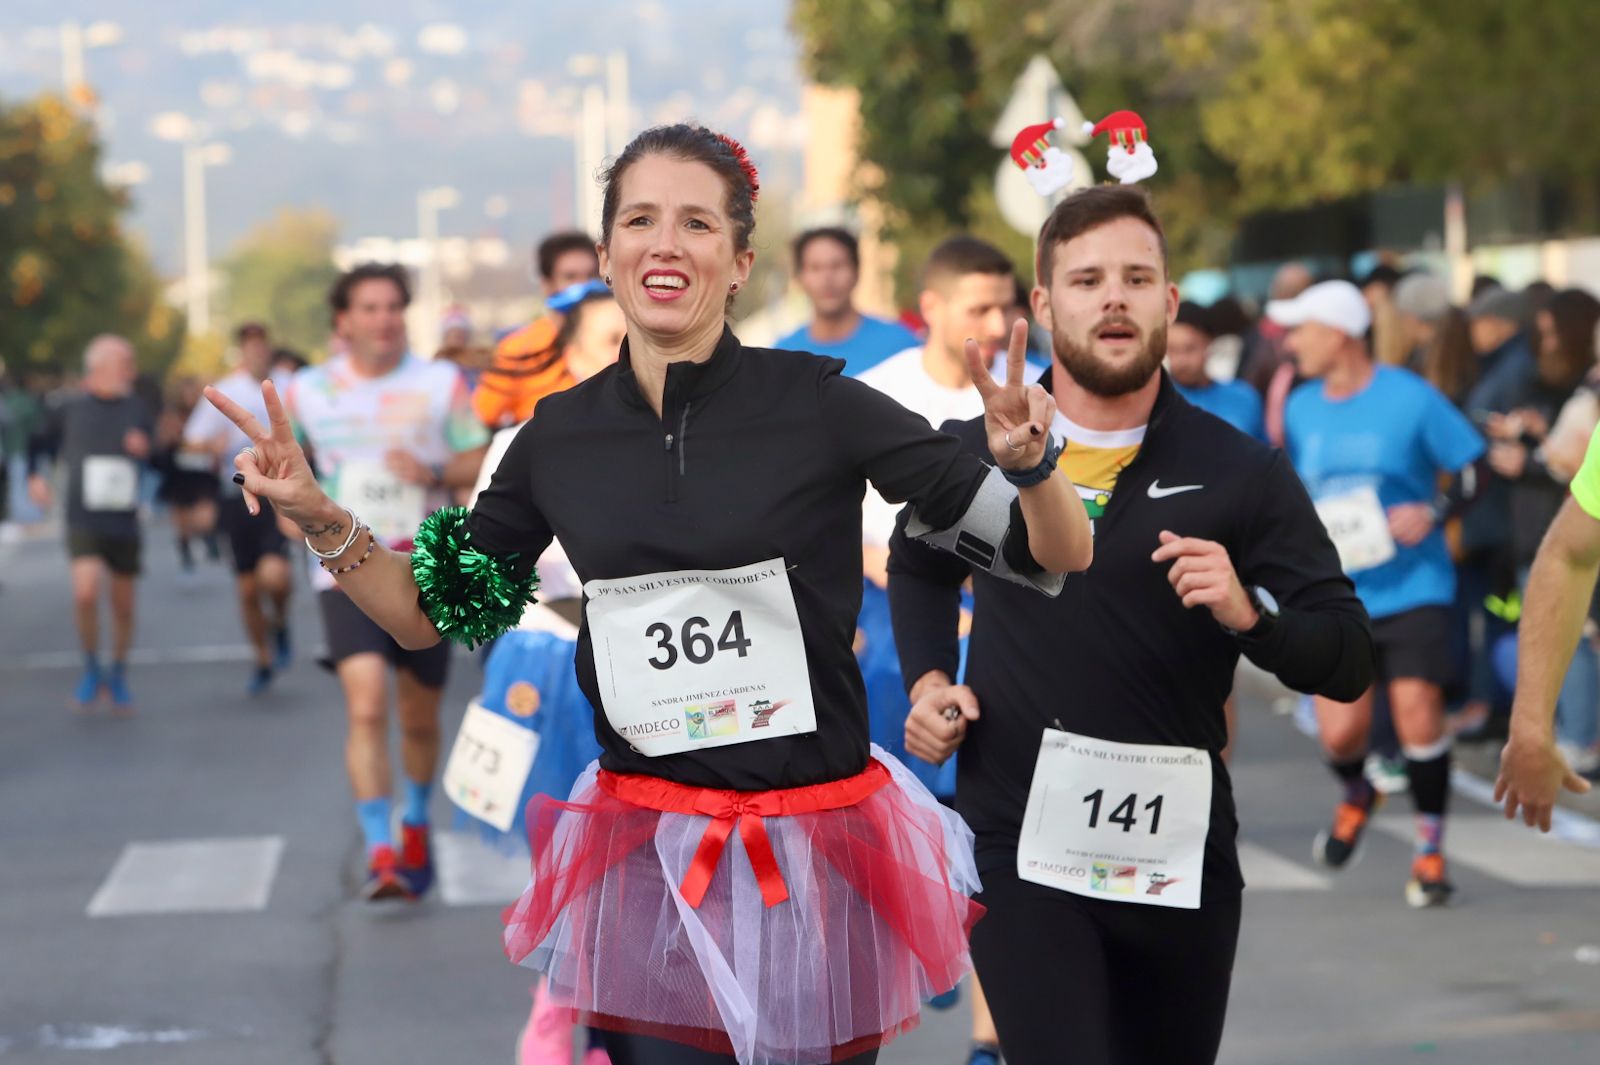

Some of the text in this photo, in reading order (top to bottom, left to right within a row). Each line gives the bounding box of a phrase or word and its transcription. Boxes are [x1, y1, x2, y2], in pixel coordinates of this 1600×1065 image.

[614, 586, 637, 596] SAN
[639, 576, 703, 593] SILVESTRE
[705, 569, 777, 585] CORDOBESA
[645, 610, 751, 670] 364
[651, 683, 767, 707] SANDRA JIMÉNEZ CÁRDENAS
[629, 718, 680, 736] IMDECO
[1071, 745, 1091, 757] SAN
[1093, 751, 1148, 764] SILVESTRE
[1150, 755, 1204, 767] CORDOBESA
[1083, 788, 1164, 835] 141
[1040, 862, 1087, 878] IMDECO
